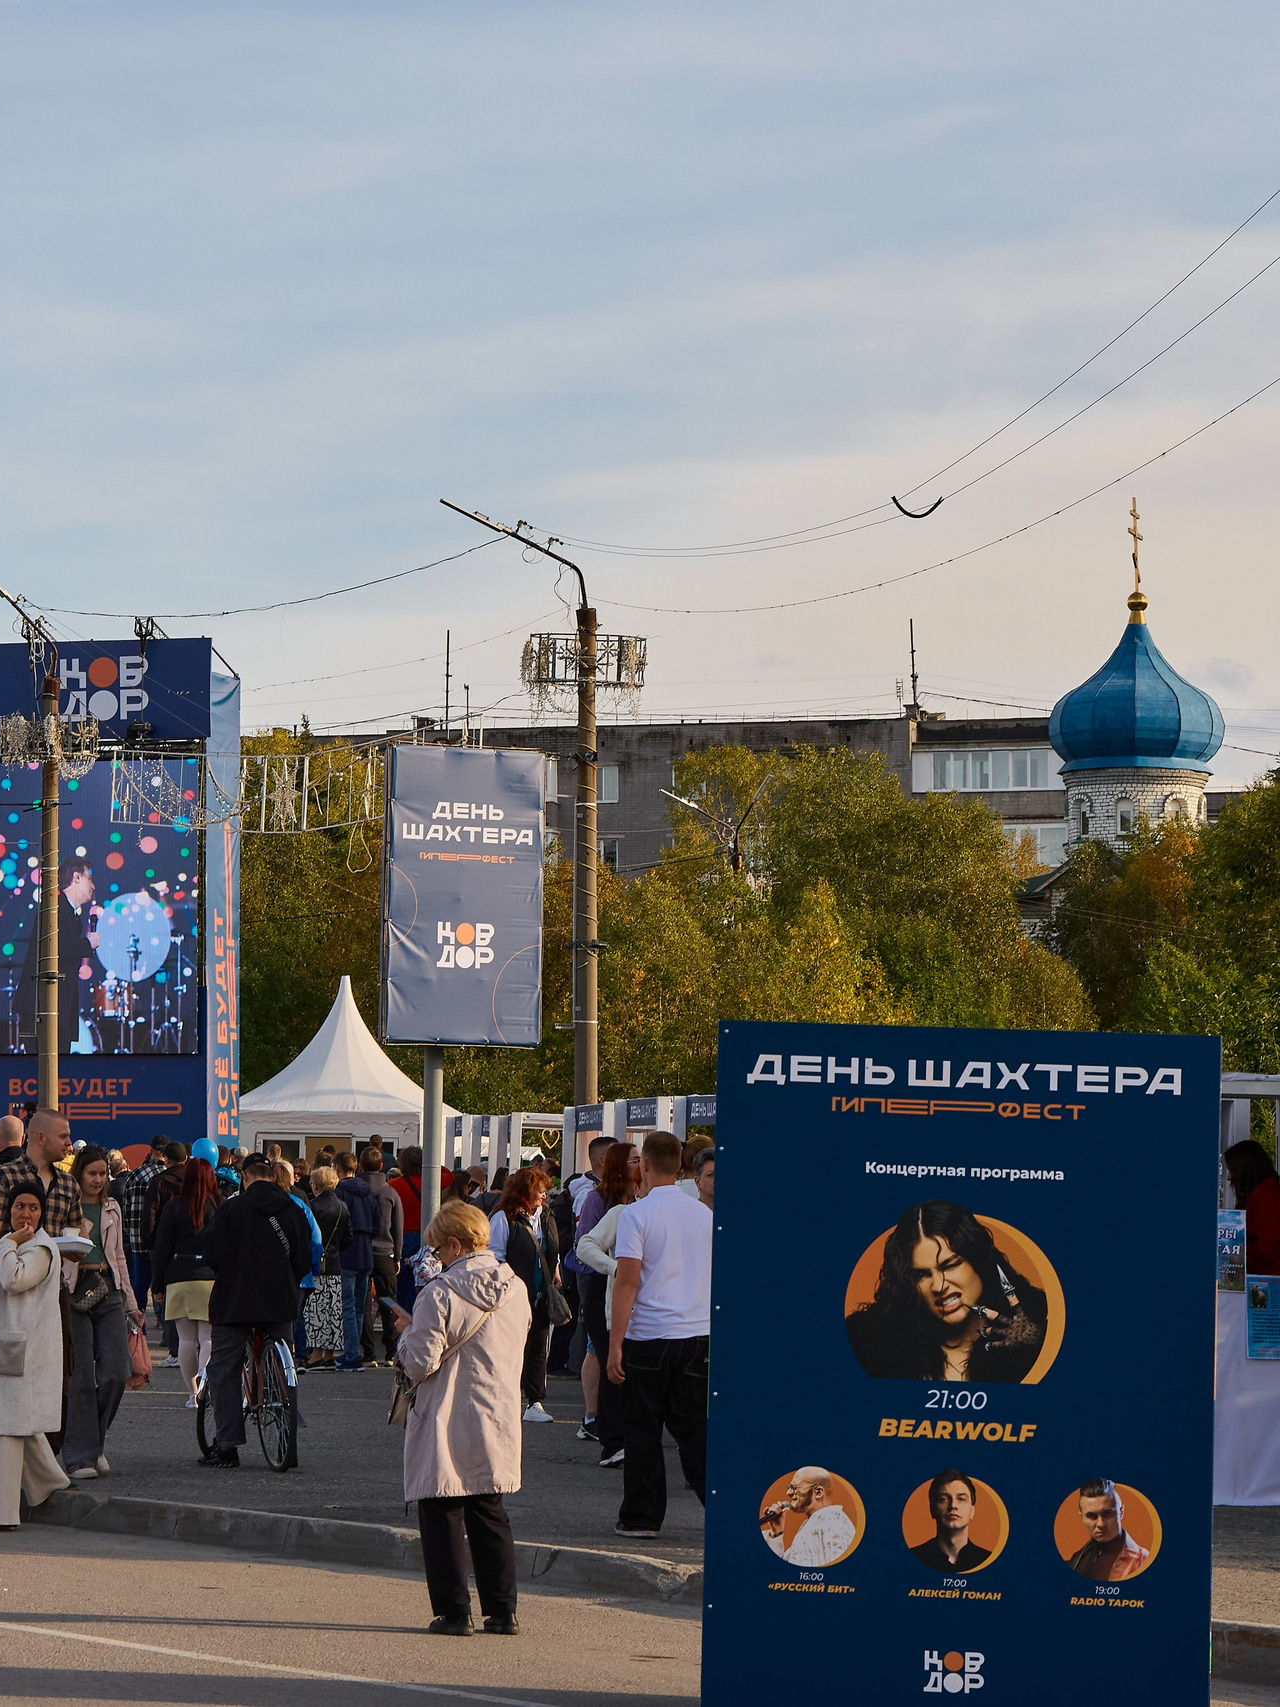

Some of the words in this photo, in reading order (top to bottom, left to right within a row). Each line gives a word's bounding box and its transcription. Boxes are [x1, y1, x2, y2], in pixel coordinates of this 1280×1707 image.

[431, 801, 505, 821] ДЕНЬ
[402, 822, 534, 846] ШАХТЕРА
[419, 851, 515, 864] ГИПЕРФЕСТ
[214, 908, 229, 1044] БУДЕТ
[223, 821, 238, 1136] ГИПЕР
[746, 1053, 896, 1086] ДЕНЬ
[907, 1059, 1182, 1096] ШАХТЕРА
[9, 1078, 38, 1096] ВС
[58, 1078, 133, 1099] БУДЕТ
[214, 1057, 230, 1136] ВСЁ
[690, 1102, 706, 1119] ДЕНЬ
[831, 1096, 1086, 1121] ГИПЕРФЕСТ
[865, 1161, 966, 1178] Концертная
[970, 1167, 1065, 1182] программа
[924, 1389, 988, 1410] 21:00
[878, 1418, 1037, 1443] BEARWOLF
[799, 1572, 824, 1582] 16:00
[943, 1578, 967, 1588] 17:00
[767, 1582, 825, 1593] «РУССКИЙ
[827, 1584, 856, 1594] БИТ»
[908, 1588, 960, 1599] АЛЕКСЕЙ
[962, 1590, 1002, 1601] ГОМАН
[1095, 1586, 1120, 1596] 19:00
[1070, 1596, 1106, 1607] RADIO
[1108, 1598, 1145, 1609] TAPOK
